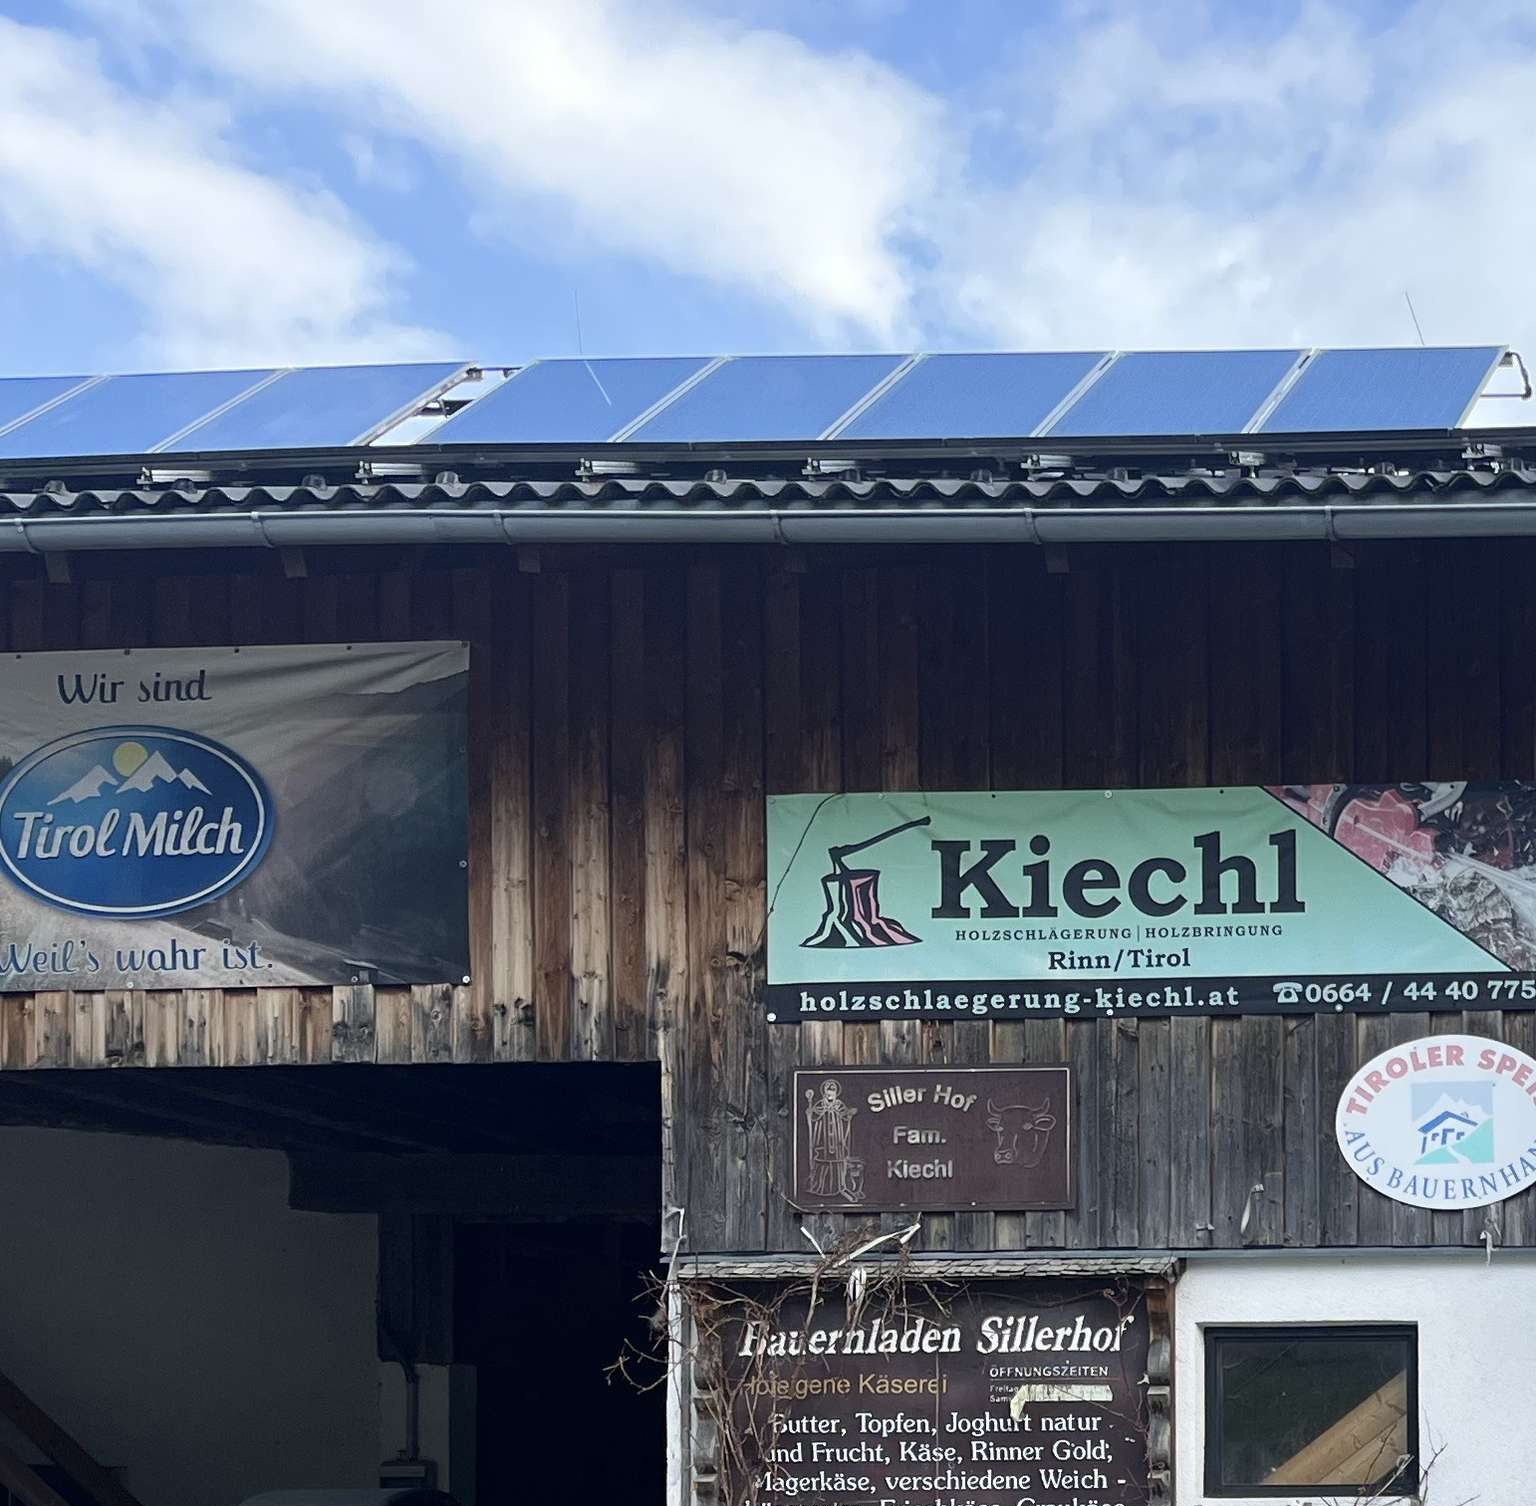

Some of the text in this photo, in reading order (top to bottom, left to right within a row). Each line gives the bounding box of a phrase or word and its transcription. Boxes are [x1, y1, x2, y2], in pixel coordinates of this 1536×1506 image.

[57, 669, 213, 705] Wir sind
[13, 806, 245, 859] Tirol Milch
[931, 829, 1306, 919] Kiechl
[955, 925, 1283, 941] HOLZSCHLÄGERUNG HOLZBRINGUNG
[116, 938, 207, 971] wahr
[222, 939, 273, 969] ist.
[1048, 948, 1190, 973] Rinn/Tirol
[799, 985, 1240, 1014] holzschlaegerung-kiechl.at
[1305, 982, 1372, 1003] 0664
[1403, 981, 1437, 1001] 44
[1445, 980, 1479, 1000] 40
[1346, 1044, 1464, 1115] TIROLER
[867, 1084, 978, 1113] Siller Hof
[892, 1126, 947, 1144] Fam.
[1344, 1129, 1385, 1177] AUS
[886, 1158, 953, 1179] Kiechl
[976, 1315, 1135, 1354] Sillerhof
[859, 1374, 947, 1395] Käserei
[855, 1412, 937, 1437] Topfen,
[945, 1411, 1032, 1436] Joghurt
[1041, 1414, 1102, 1432] natur
[811, 1441, 890, 1464] Frucht,
[899, 1441, 963, 1464] Käse,
[971, 1441, 1044, 1462] Rinner
[885, 1469, 1031, 1490] verschiedene
